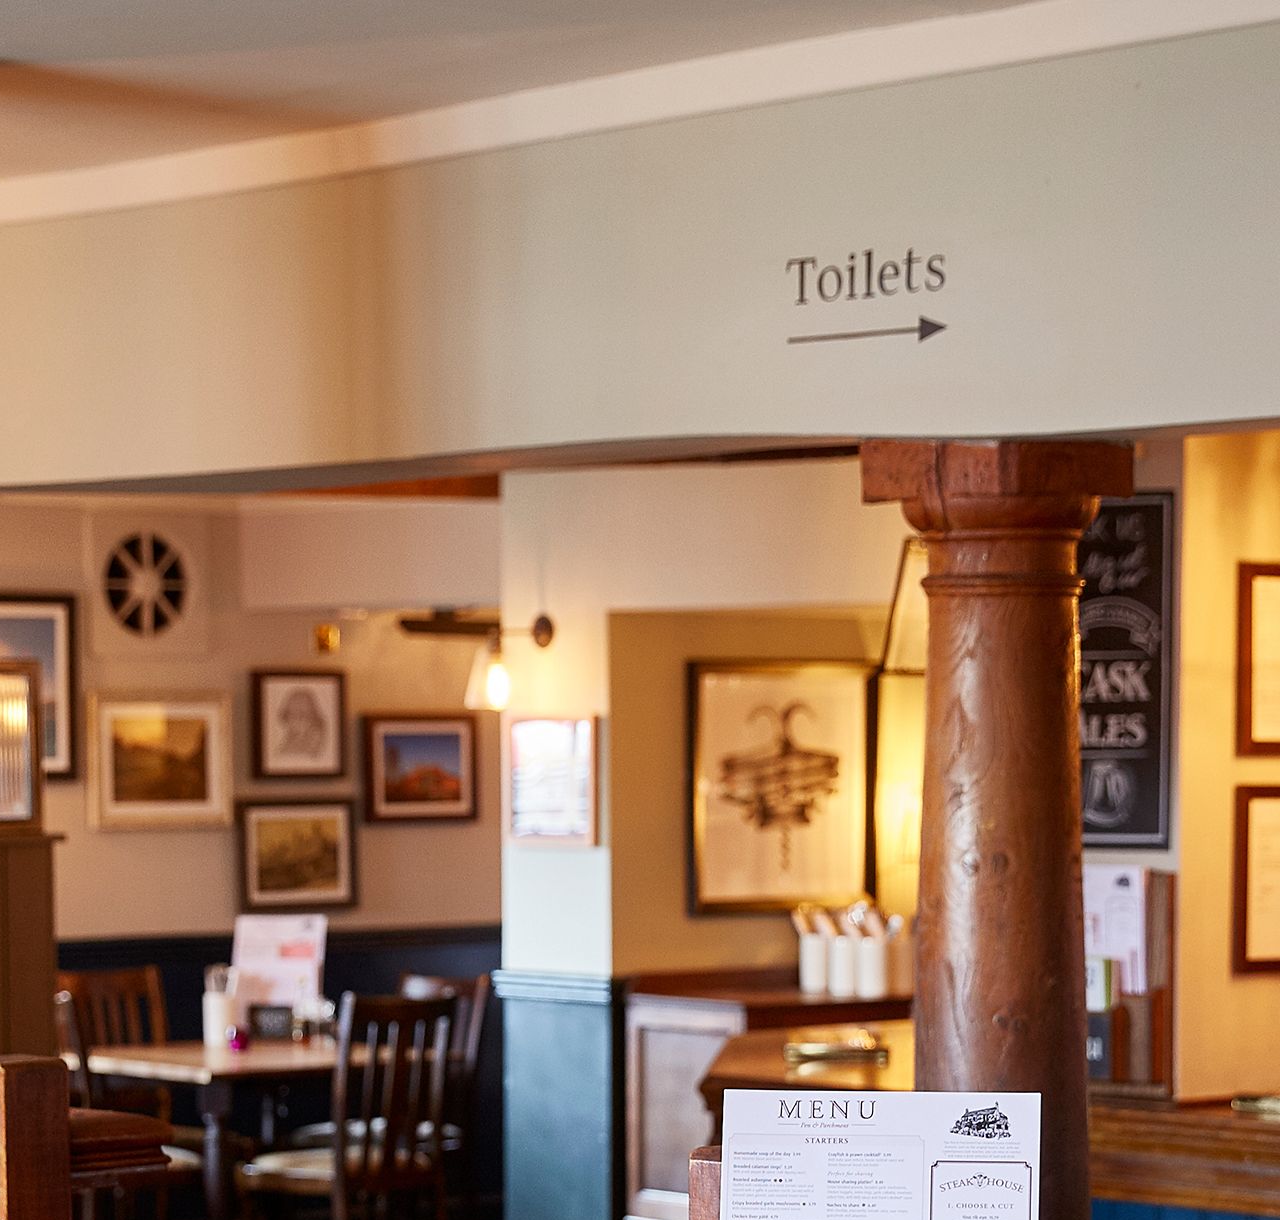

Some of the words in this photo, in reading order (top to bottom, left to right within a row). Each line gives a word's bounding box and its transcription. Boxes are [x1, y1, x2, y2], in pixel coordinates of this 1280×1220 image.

[785, 247, 946, 306] Toilets
[1080, 660, 1151, 702] ASK
[778, 1099, 876, 1119] MENU
[939, 1178, 975, 1193] STEAK
[986, 1177, 1025, 1194] HOUSE
